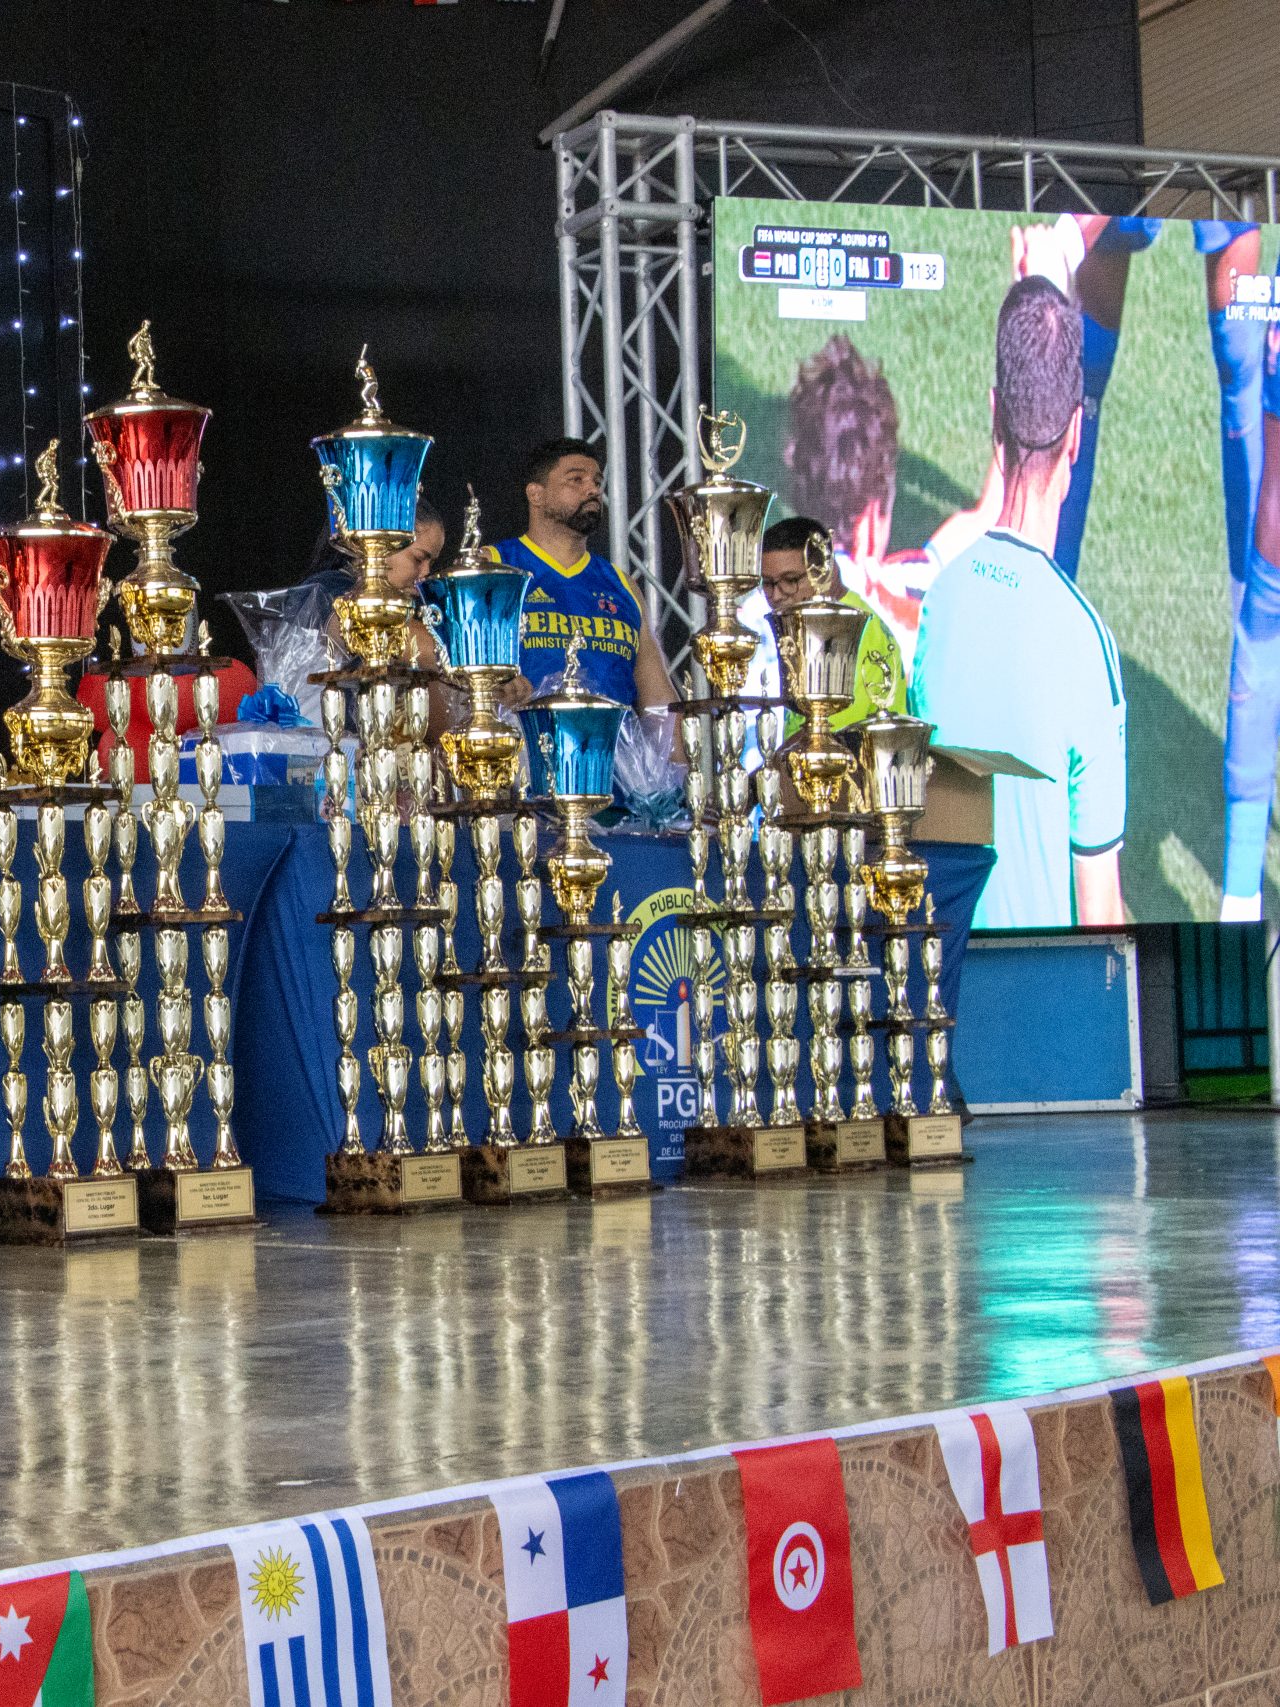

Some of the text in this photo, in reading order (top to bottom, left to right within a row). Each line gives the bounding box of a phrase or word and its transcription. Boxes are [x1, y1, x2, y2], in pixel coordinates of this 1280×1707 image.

[774, 230, 800, 244] WORLD
[800, 231, 815, 245] CUP
[774, 253, 797, 275] PAR
[848, 256, 870, 278] FRA
[1225, 305, 1245, 320] LIVE
[527, 611, 639, 654] ERRERA
[523, 637, 632, 661] MINISTEO PÚBLICO
[650, 893, 693, 917] PÚBLIC
[661, 1147, 671, 1156] DE
[213, 1193, 229, 1201] Lugar
